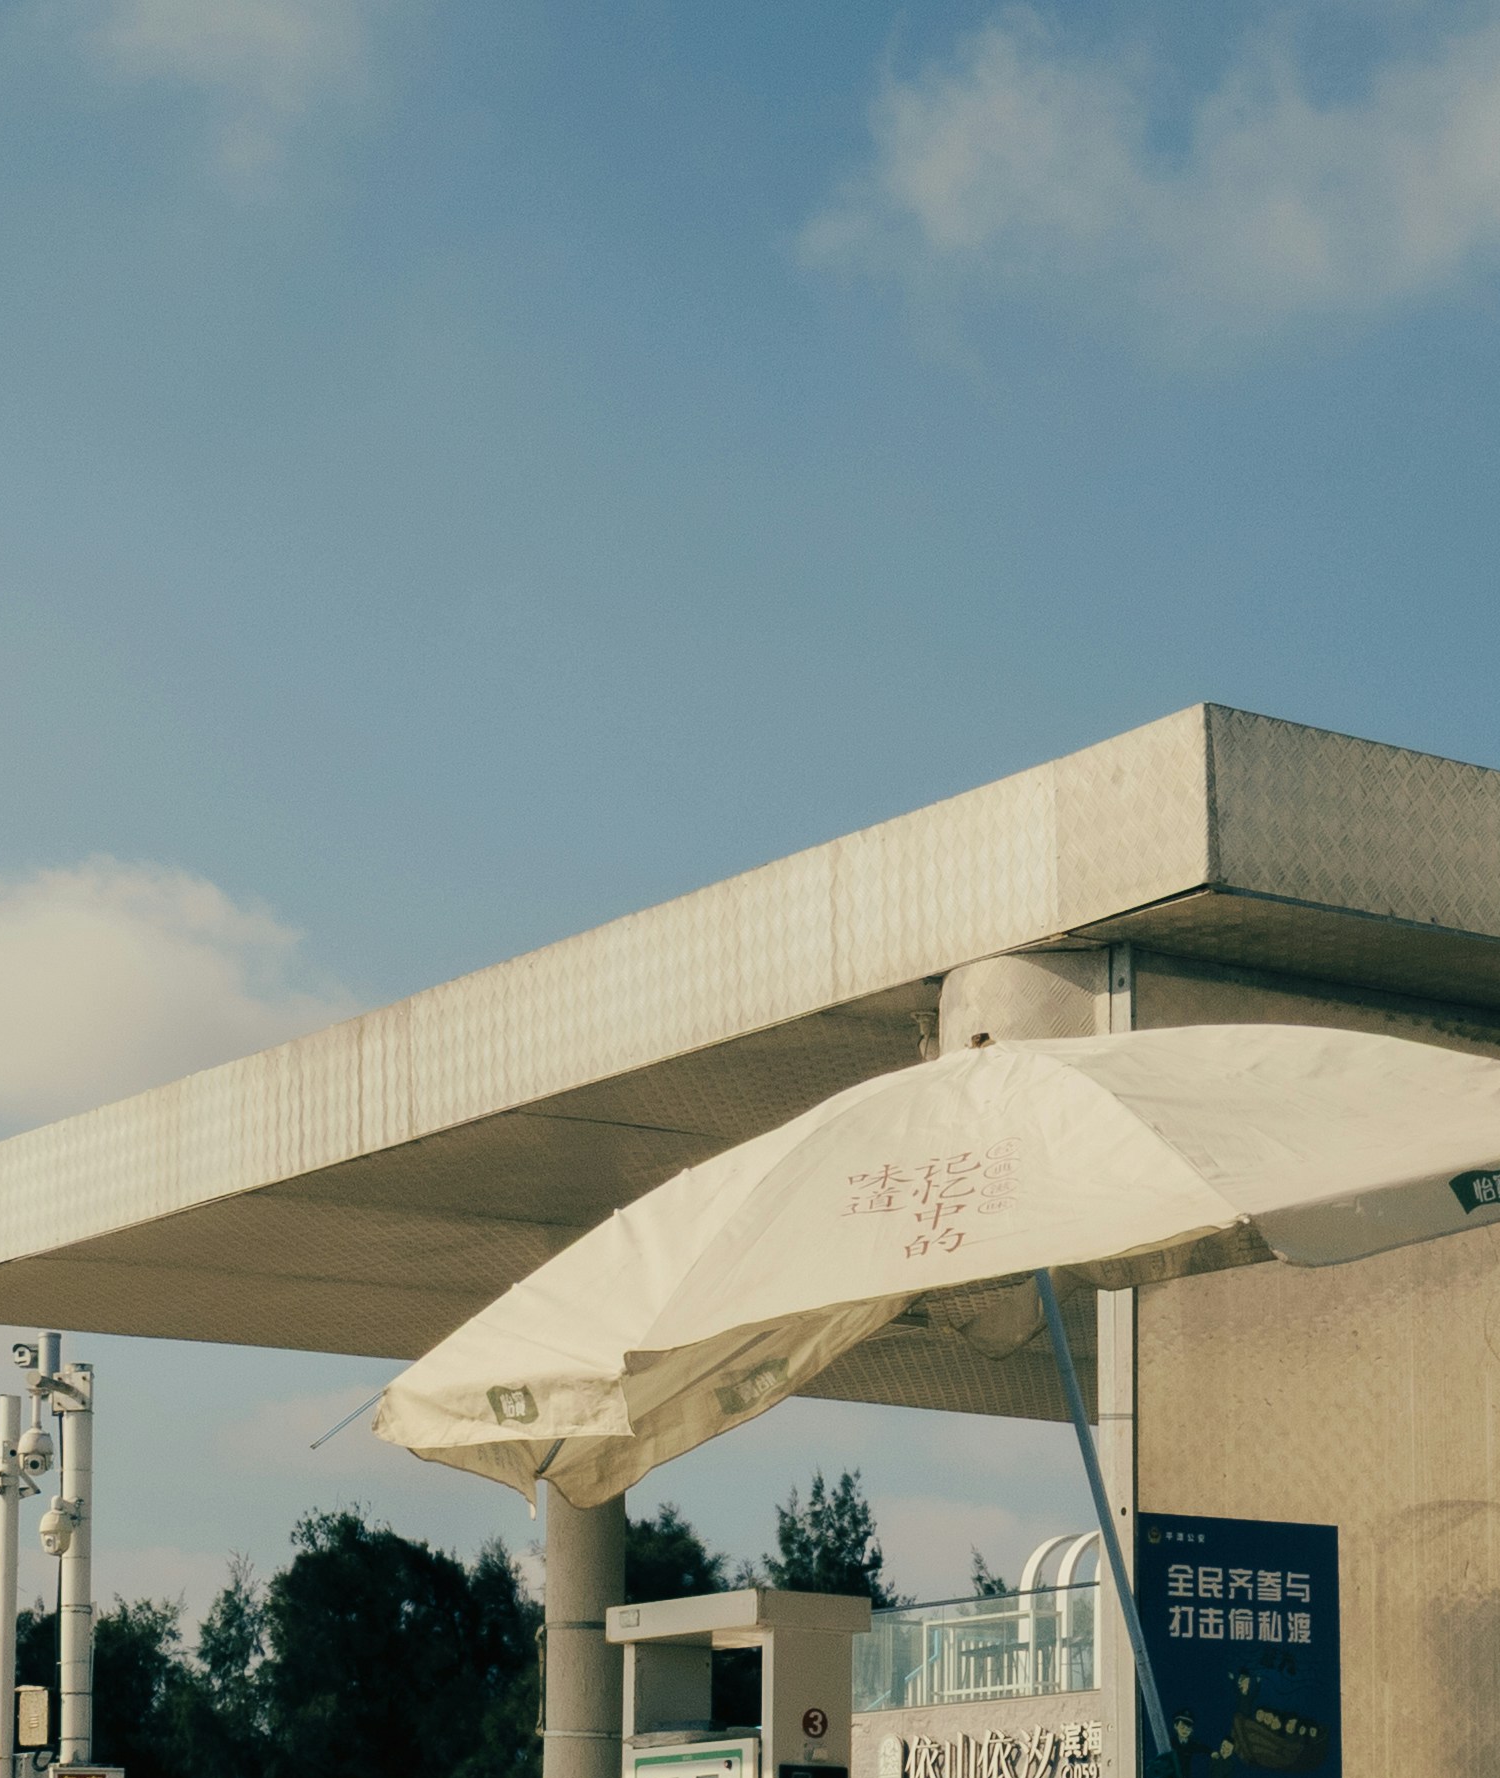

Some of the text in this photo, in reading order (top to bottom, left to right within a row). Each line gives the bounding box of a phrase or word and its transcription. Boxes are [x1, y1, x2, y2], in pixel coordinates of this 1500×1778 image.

[841, 1163, 914, 1217] 味道
[1167, 1564, 1310, 1603] 全民齐参与
[1168, 1605, 1311, 1644] 打击偷私渡
[808, 1711, 823, 1735] 3
